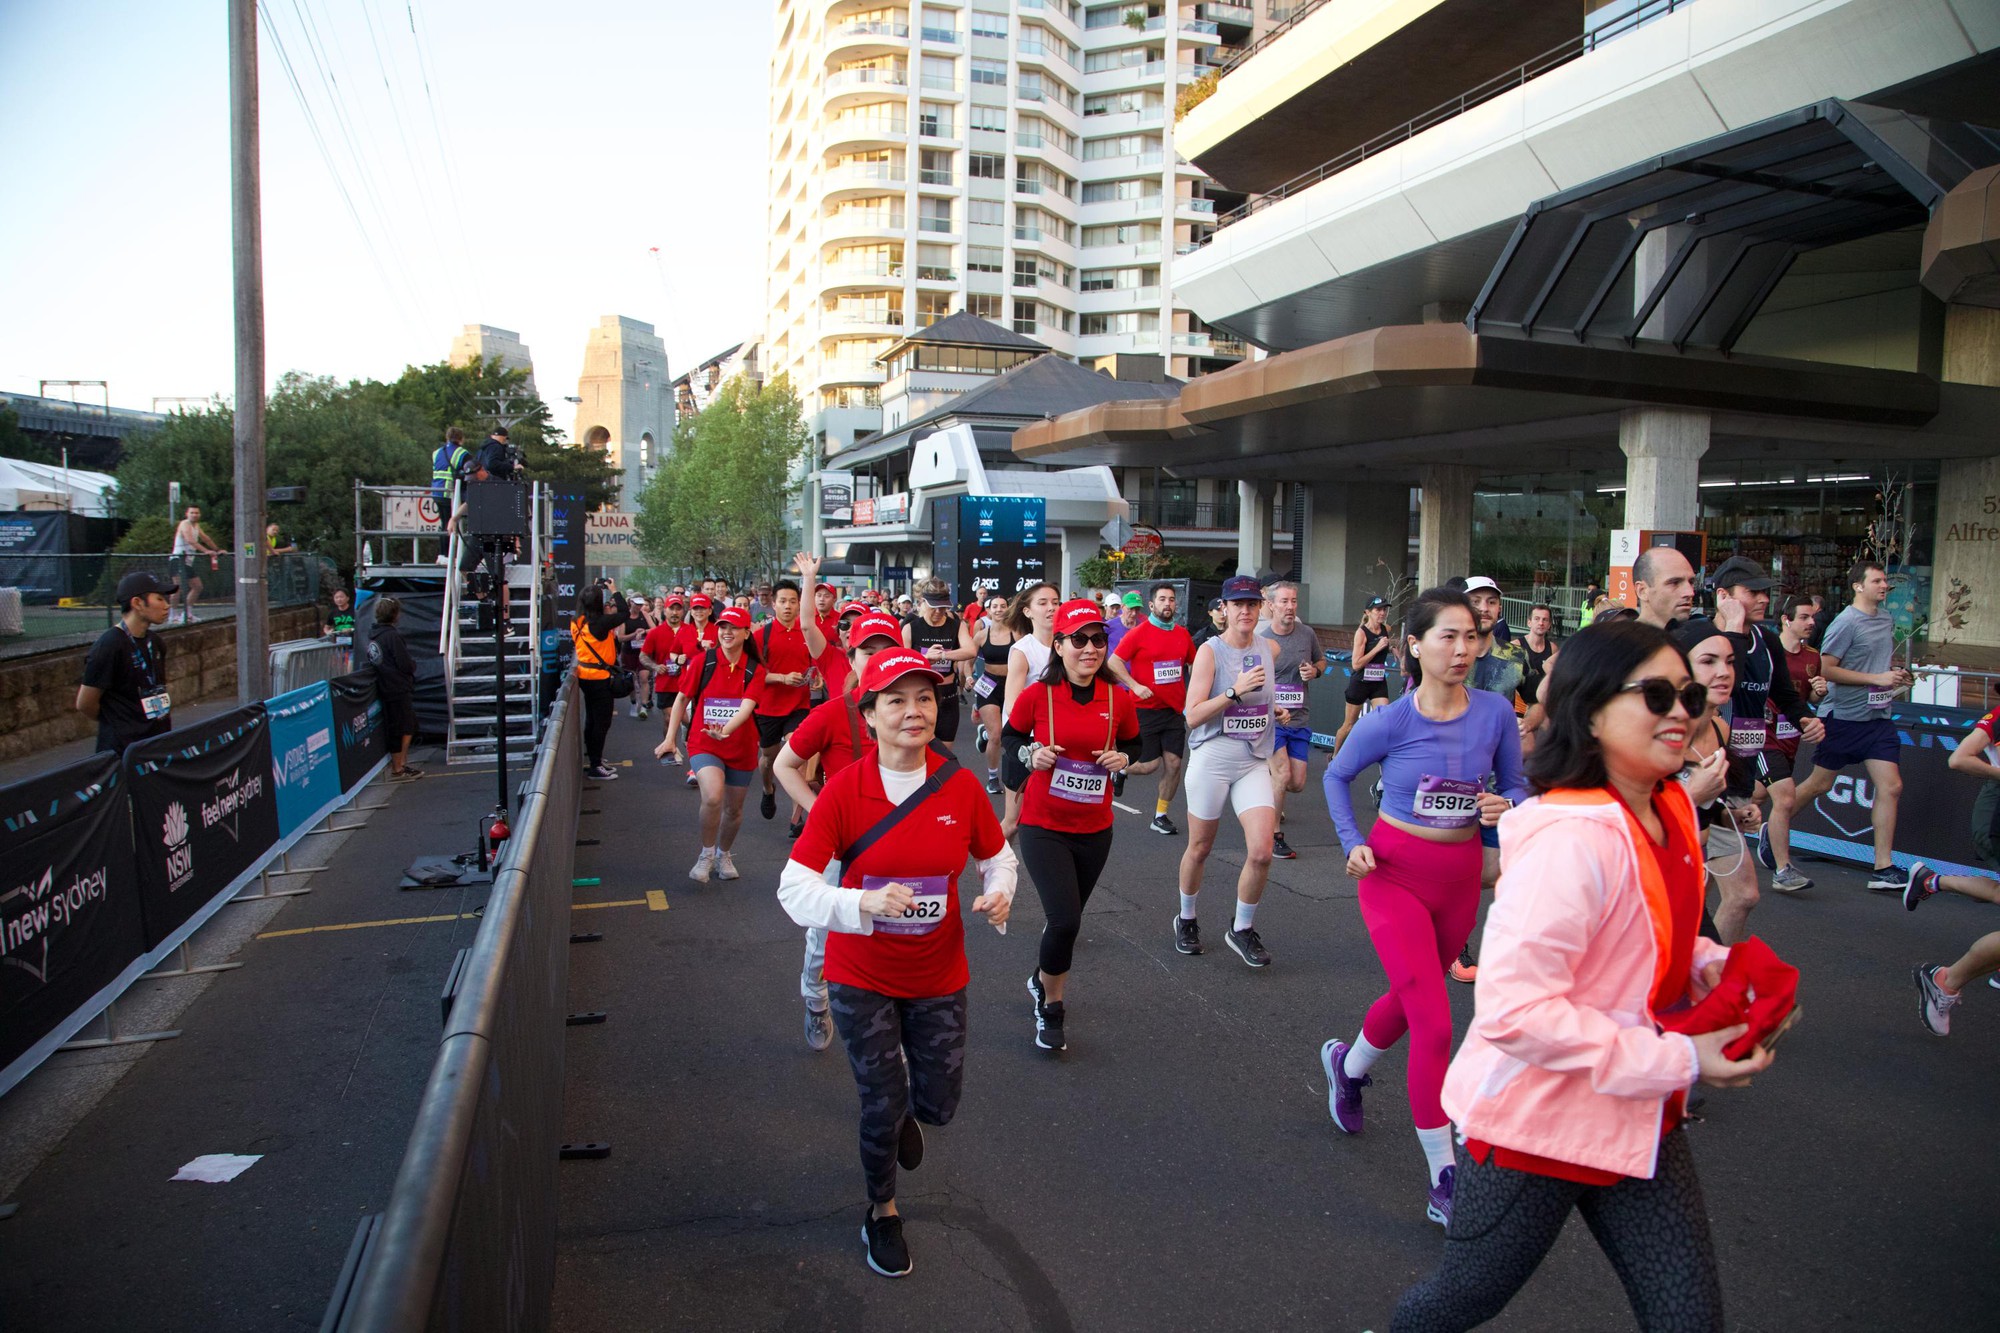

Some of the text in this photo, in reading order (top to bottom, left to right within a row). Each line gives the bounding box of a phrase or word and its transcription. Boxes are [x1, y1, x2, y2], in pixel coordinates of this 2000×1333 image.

[824, 493, 848, 501] senses
[592, 516, 629, 528] LUNA
[1619, 571, 1628, 601] FOR
[1227, 717, 1267, 730] C70566
[1055, 773, 1103, 792] A53128
[201, 795, 221, 829] feel
[220, 790, 240, 818] new
[166, 843, 192, 882] NSW
[8, 901, 50, 951] new
[52, 865, 107, 926] sydney
